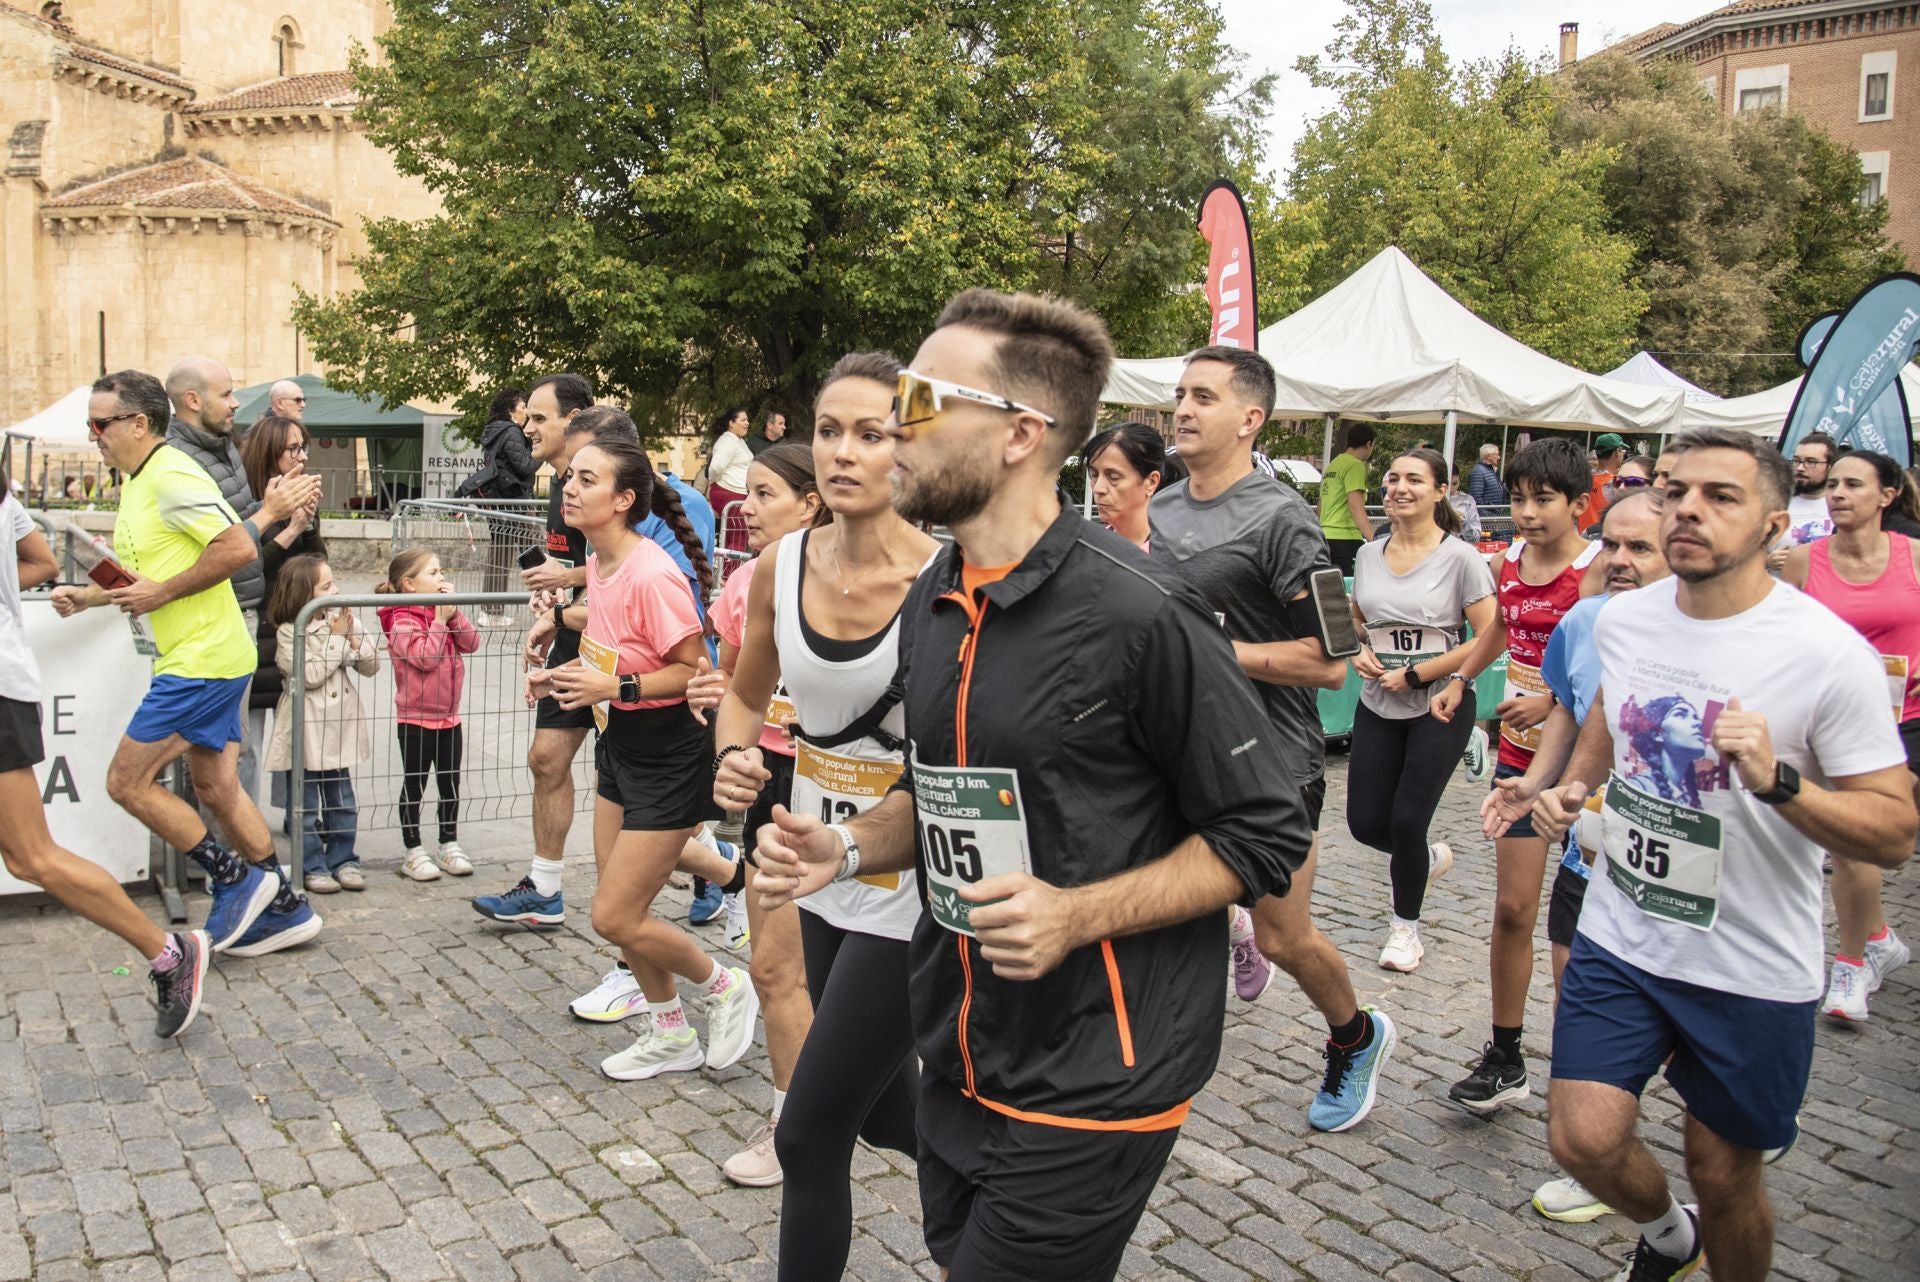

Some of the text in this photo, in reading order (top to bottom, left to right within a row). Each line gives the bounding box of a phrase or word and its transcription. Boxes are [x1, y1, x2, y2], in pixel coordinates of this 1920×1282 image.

[1389, 629, 1424, 651] 167
[1672, 667, 1701, 679] popular
[818, 767, 857, 783] cajarural
[825, 759, 856, 772] popular
[858, 763, 866, 772] 4
[867, 765, 885, 775] km.
[831, 783, 840, 791] EL
[841, 784, 875, 795] CÁNCER
[917, 774, 990, 789] popular 9 km.
[929, 803, 941, 814] EL
[940, 804, 981, 818] CÁNCER
[1630, 803, 1672, 825] cajarural
[1639, 798, 1673, 815] popular
[1643, 819, 1653, 829] EL
[1653, 823, 1688, 840] CÁNCER
[1627, 828, 1670, 879] 35
[1646, 890, 1698, 911] cajarural
